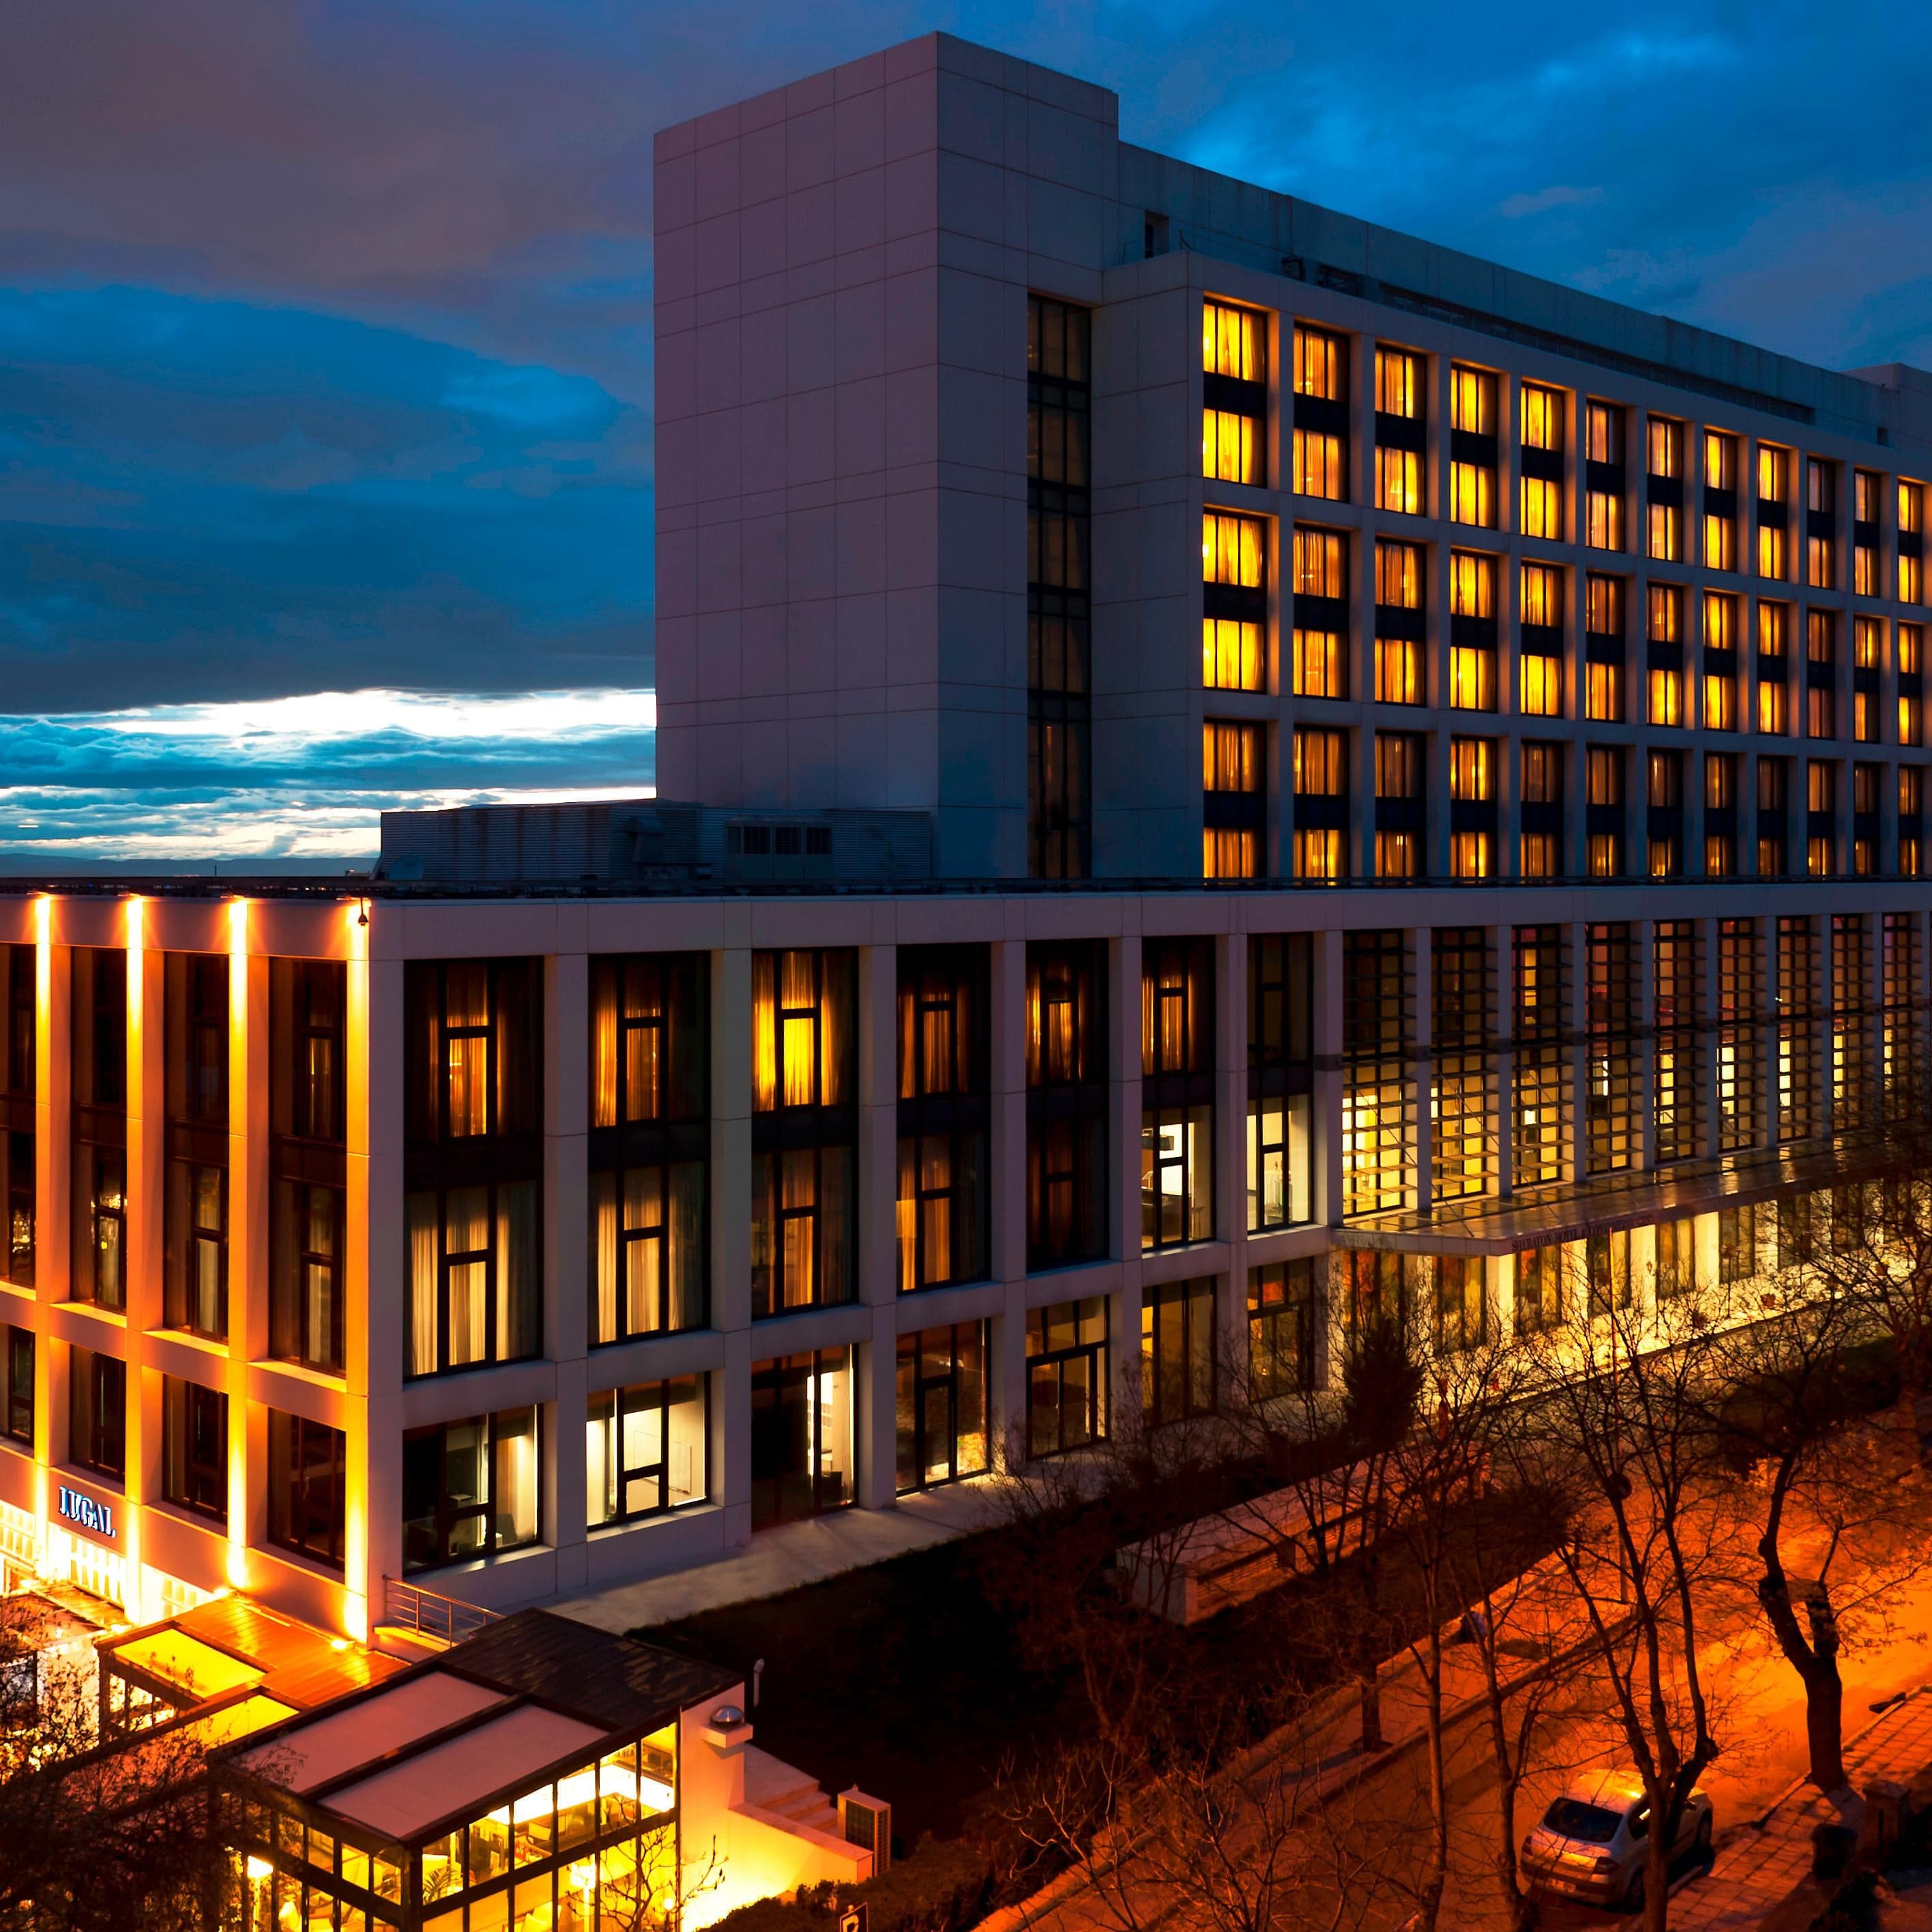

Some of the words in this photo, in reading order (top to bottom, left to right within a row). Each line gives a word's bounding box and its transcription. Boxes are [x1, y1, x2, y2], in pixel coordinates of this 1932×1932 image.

[1512, 1234, 1551, 1252] SHERATON
[1555, 1228, 1577, 1244] HOTEL
[59, 1486, 116, 1538] LUGAL
